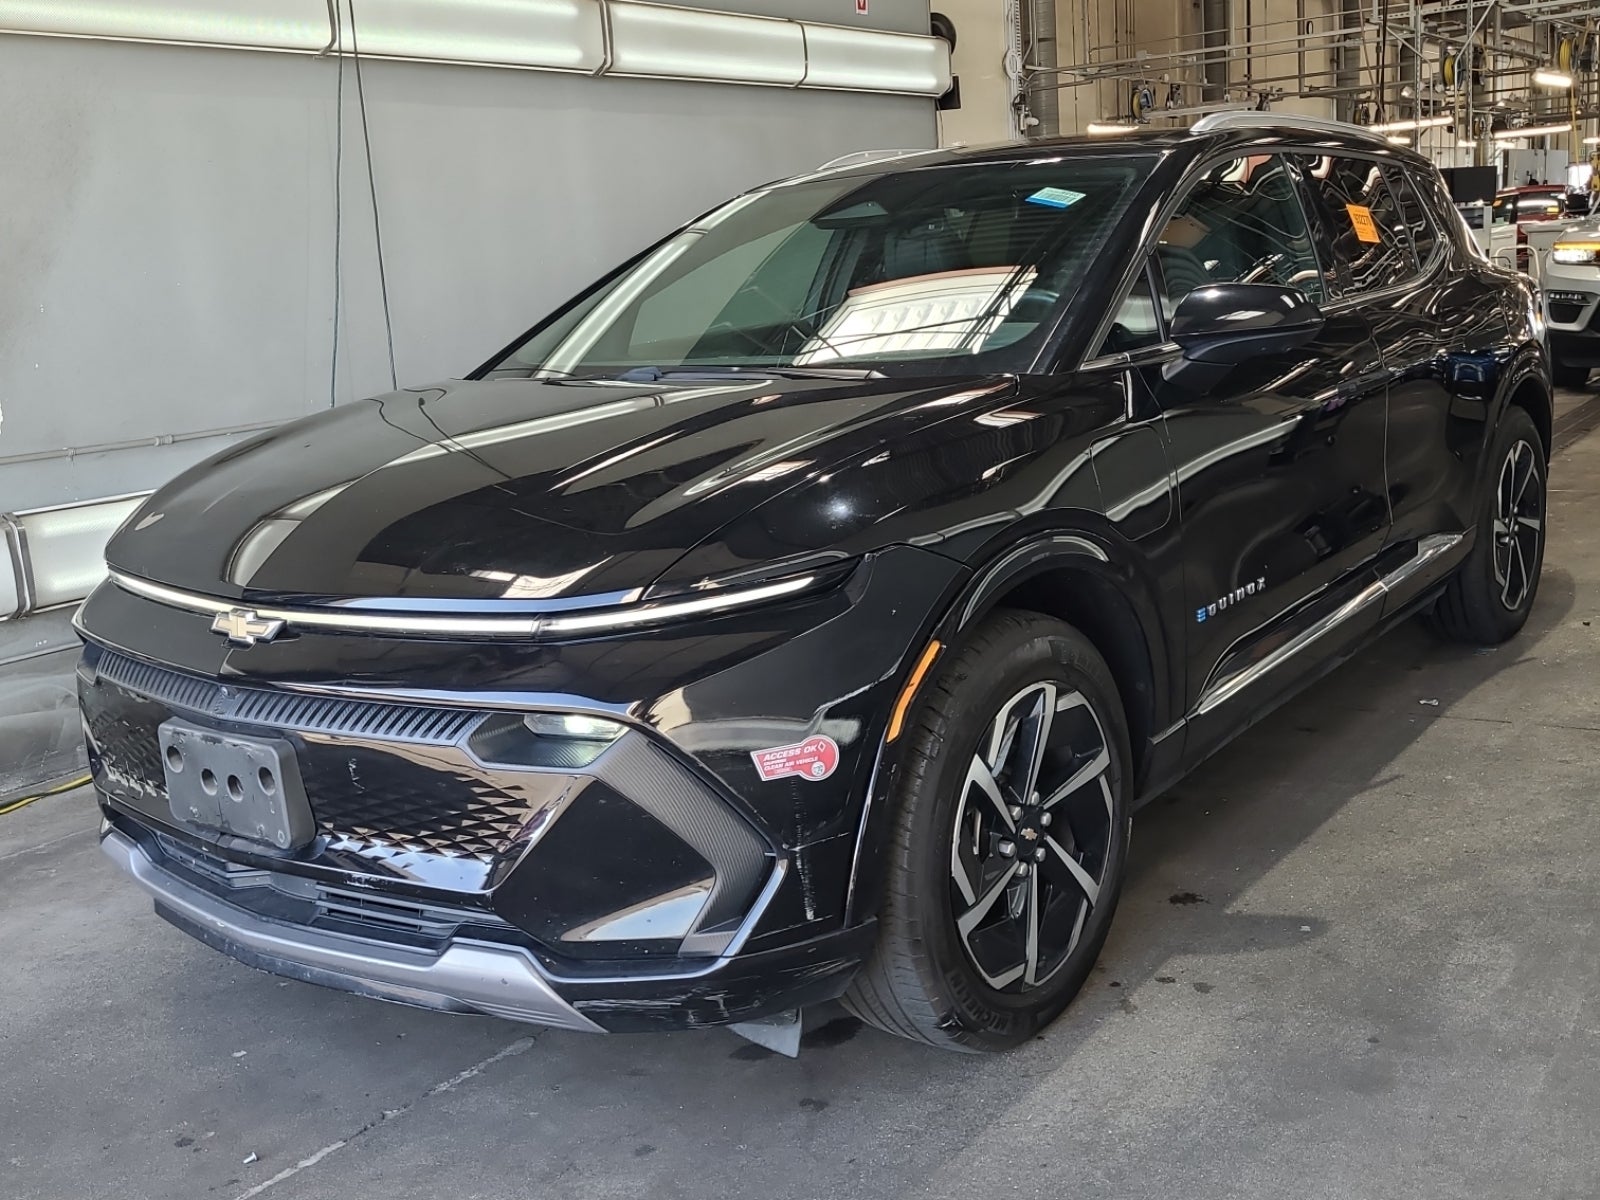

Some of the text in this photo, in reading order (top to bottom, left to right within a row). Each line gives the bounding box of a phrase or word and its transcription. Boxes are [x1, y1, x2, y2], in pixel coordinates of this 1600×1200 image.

[1196, 577, 1265, 622] EQUINOX
[763, 744, 818, 761] ACCESS OK
[764, 763, 784, 771] CLEAN
[796, 757, 819, 765] VEHICLE
